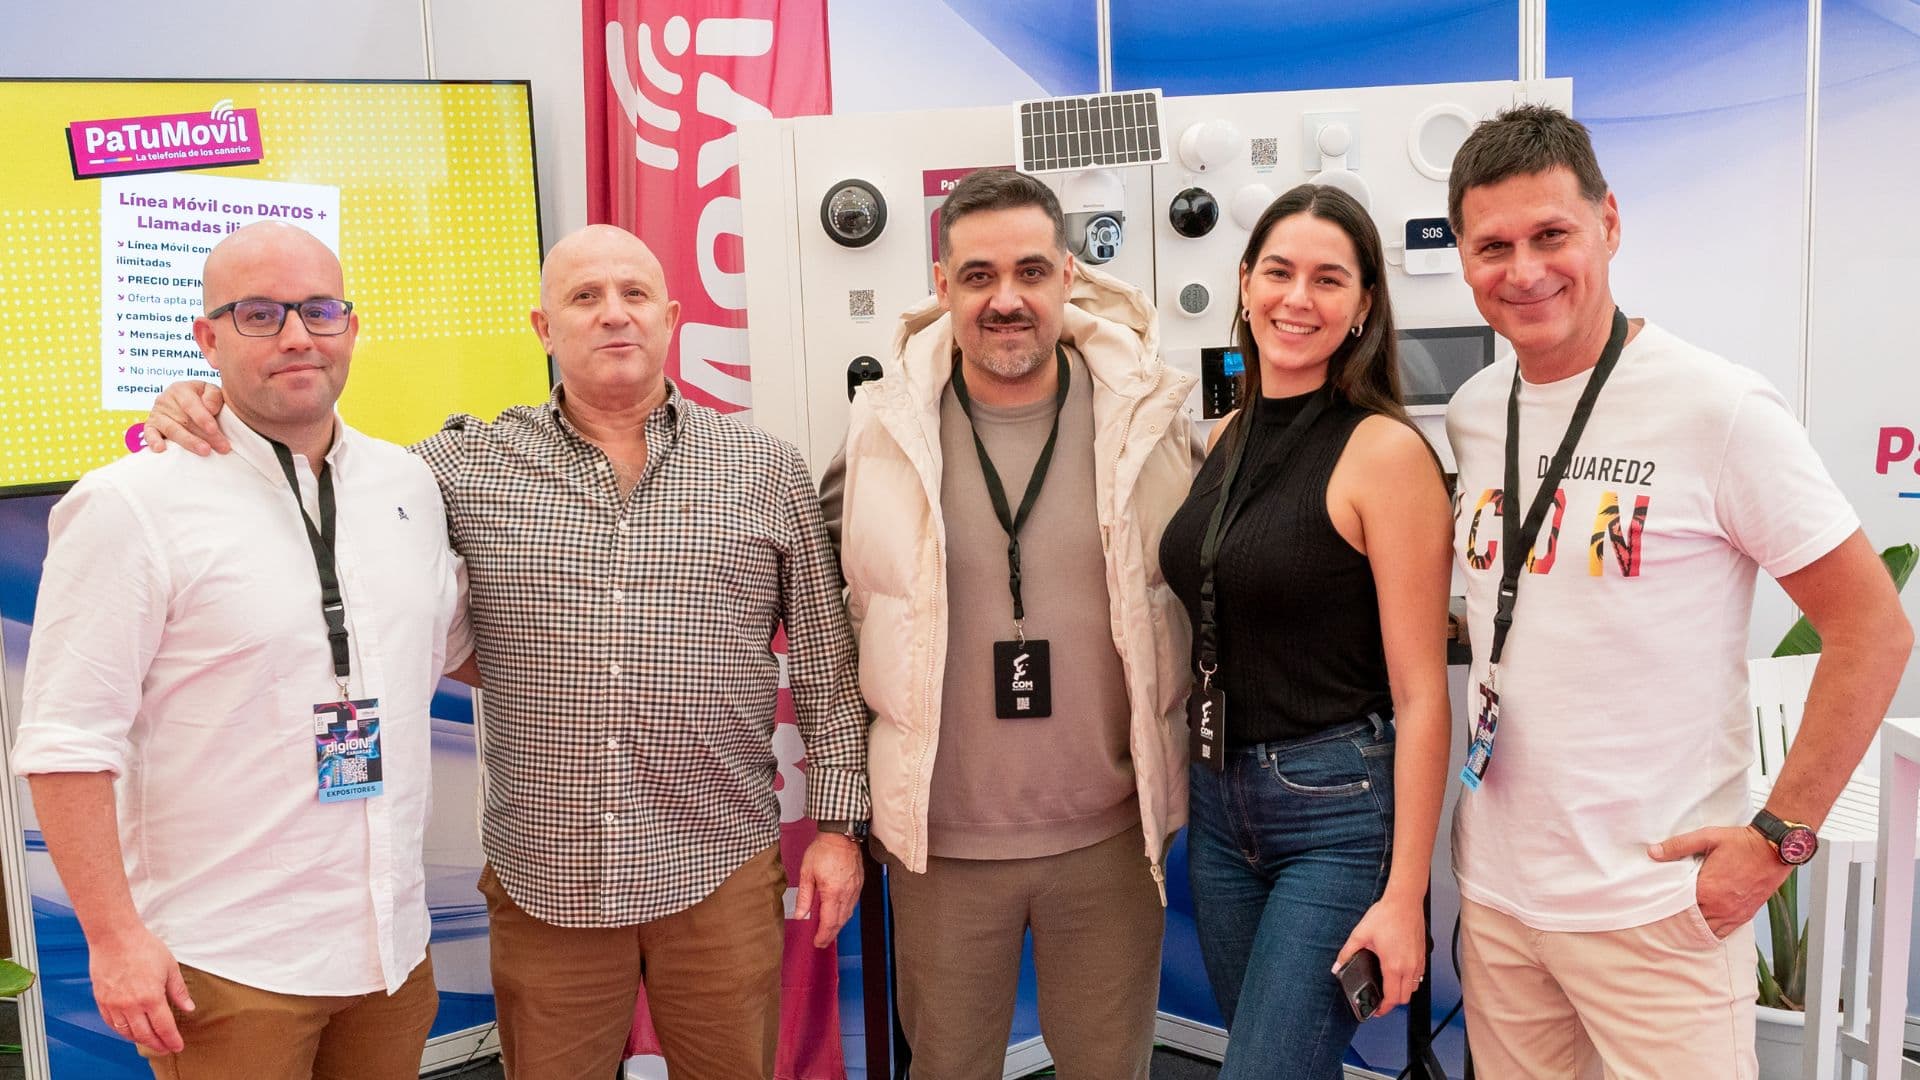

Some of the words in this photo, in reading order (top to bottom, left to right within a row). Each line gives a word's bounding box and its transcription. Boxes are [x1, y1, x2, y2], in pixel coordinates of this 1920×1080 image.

[85, 116, 249, 154] PaTuMovil
[135, 153, 147, 162] La
[188, 148, 199, 158] de
[200, 147, 213, 157] los
[214, 146, 251, 156] canarios
[119, 192, 168, 209] Línea
[172, 195, 218, 213] Móvil
[222, 202, 253, 216] con
[257, 203, 314, 220] DATOS
[137, 215, 221, 234] Llamadas
[226, 221, 241, 235] ili
[1422, 227, 1443, 239] SOS
[127, 240, 158, 251] Línea
[161, 242, 189, 253] Móvil
[192, 246, 212, 254] con
[116, 256, 172, 268] ilimitadas
[128, 275, 169, 286] PRECIO
[128, 293, 161, 304] Oferta
[163, 296, 187, 306] apta
[116, 313, 123, 321] y
[126, 312, 172, 323] cambios
[175, 314, 188, 323] de
[130, 330, 182, 341] Mensajes
[130, 348, 148, 357] SIN
[130, 366, 144, 375] No
[147, 367, 185, 377] incluye
[117, 384, 163, 394] especial
[1875, 426, 1920, 475] P
[1537, 455, 1655, 486] DUARED2
[1466, 488, 1651, 577] CON
[1012, 680, 1034, 689] COM
[326, 785, 377, 798] EXPOSITORES
